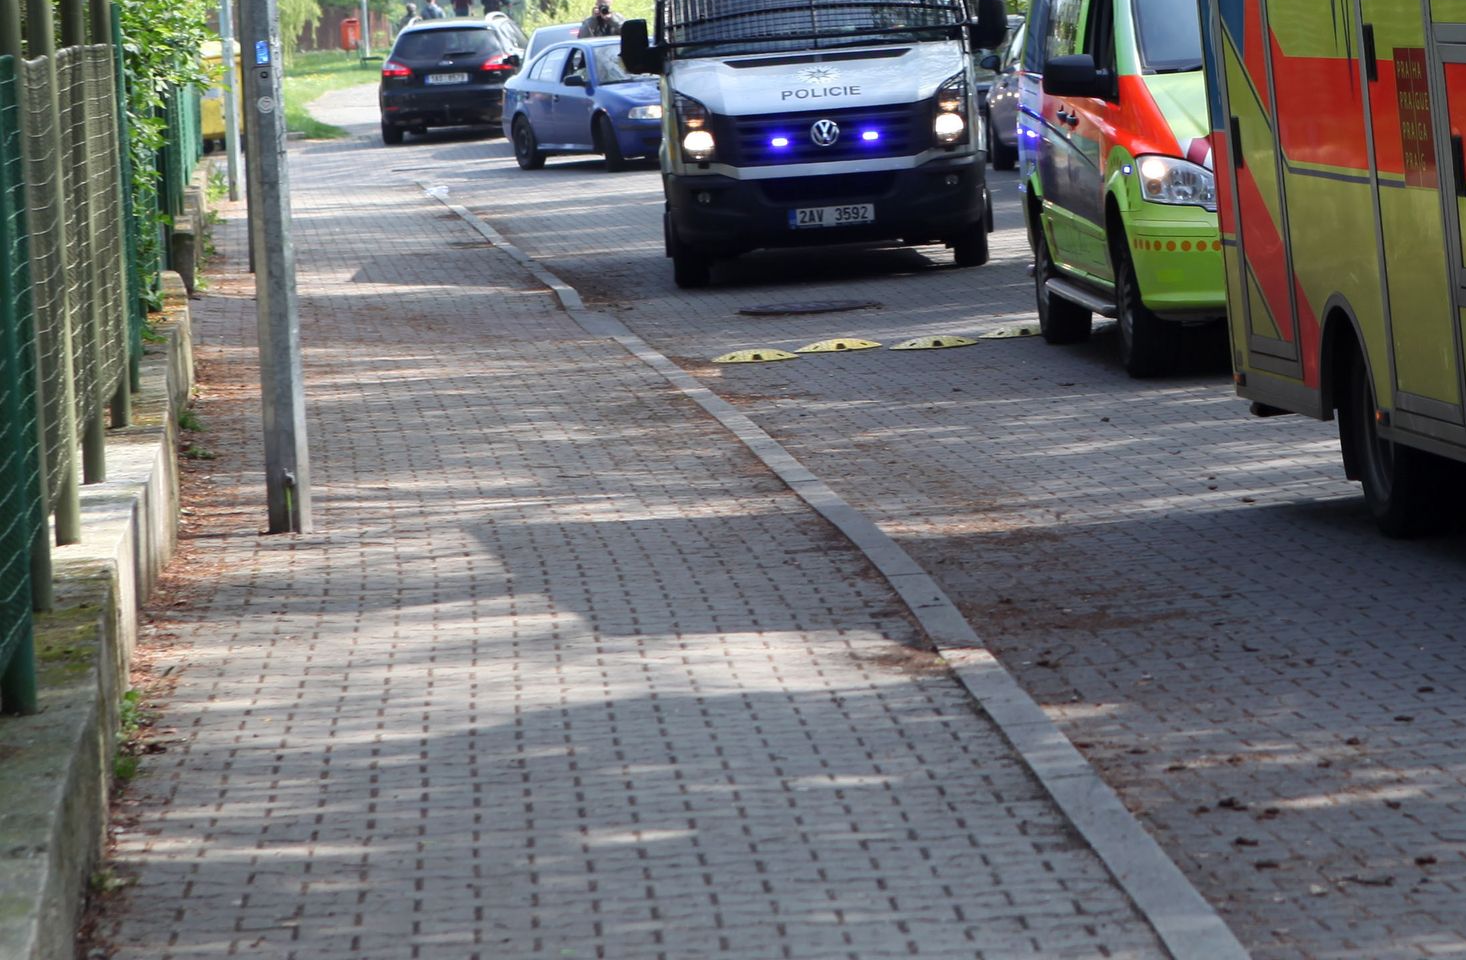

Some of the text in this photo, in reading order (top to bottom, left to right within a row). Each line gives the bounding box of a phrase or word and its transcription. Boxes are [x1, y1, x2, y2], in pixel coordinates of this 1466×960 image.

[781, 85, 861, 101] POLICIE
[799, 205, 868, 224] 2AV 3592
